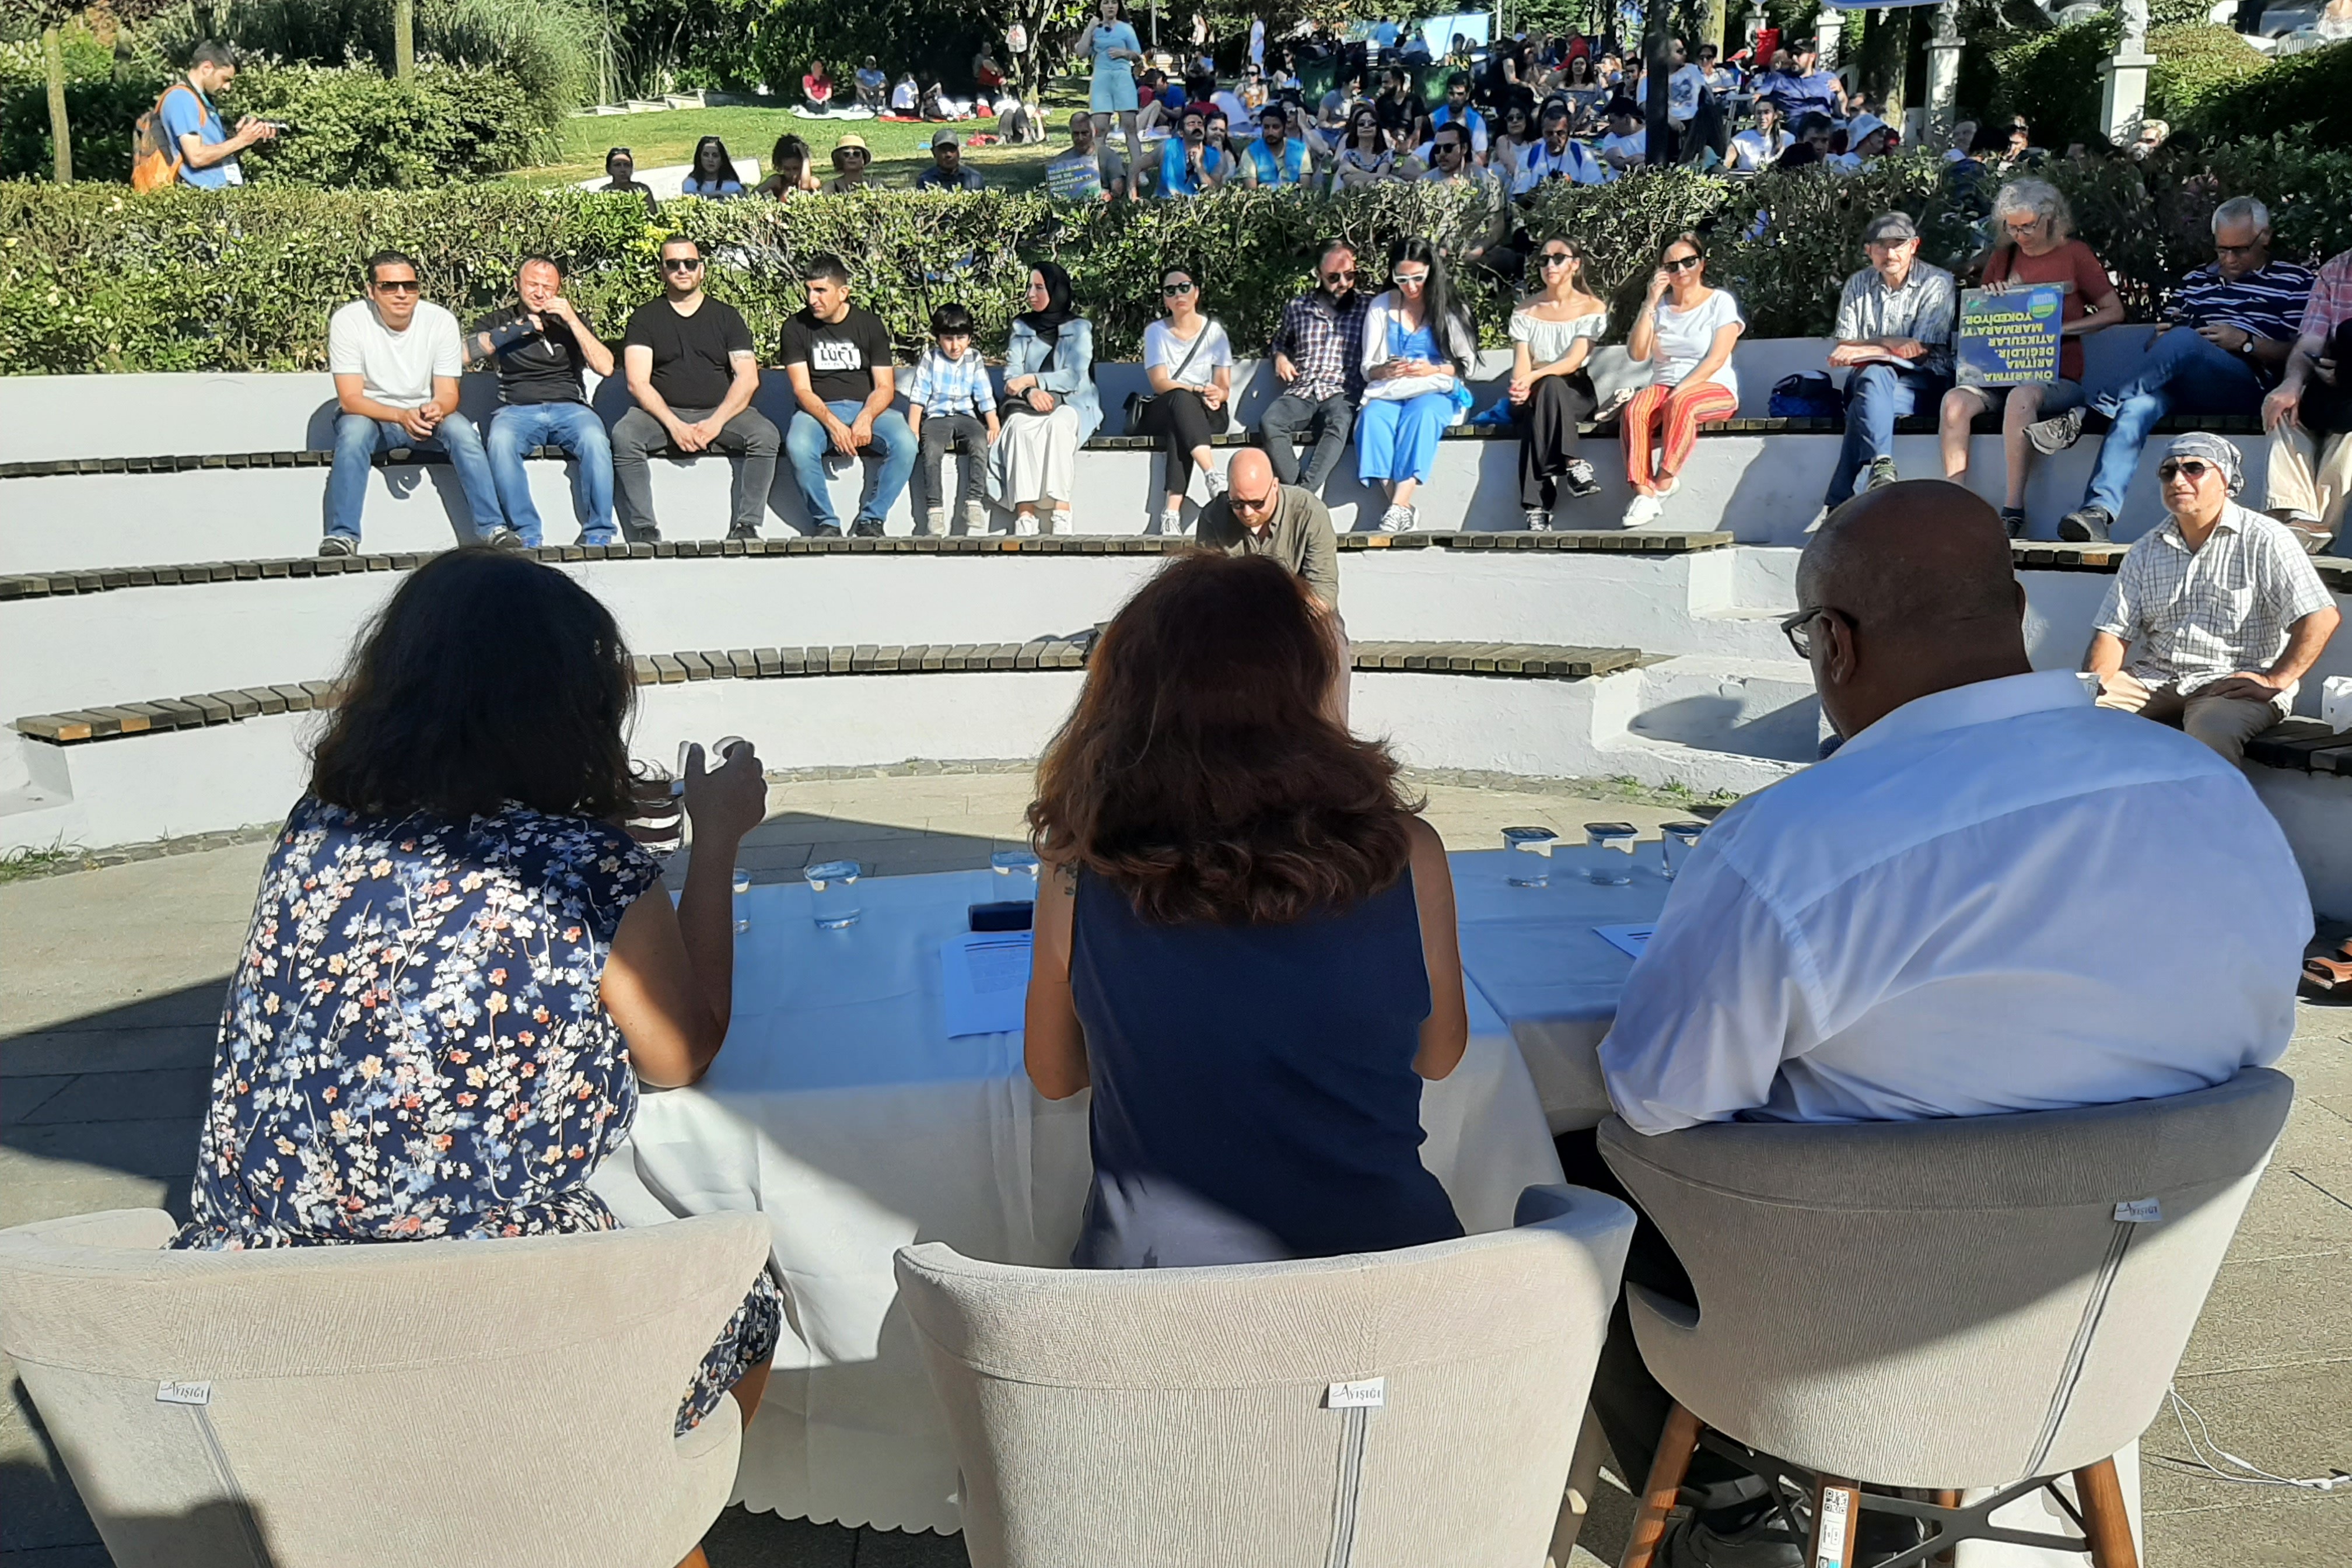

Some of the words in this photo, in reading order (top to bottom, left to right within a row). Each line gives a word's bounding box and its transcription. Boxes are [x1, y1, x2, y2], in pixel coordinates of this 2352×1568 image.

[1961, 323, 2043, 337] MARMARA'YI
[1988, 334, 2055, 346] ATIKSULAR
[818, 341, 855, 362] LOFT
[2006, 358, 2053, 369] ARITMA
